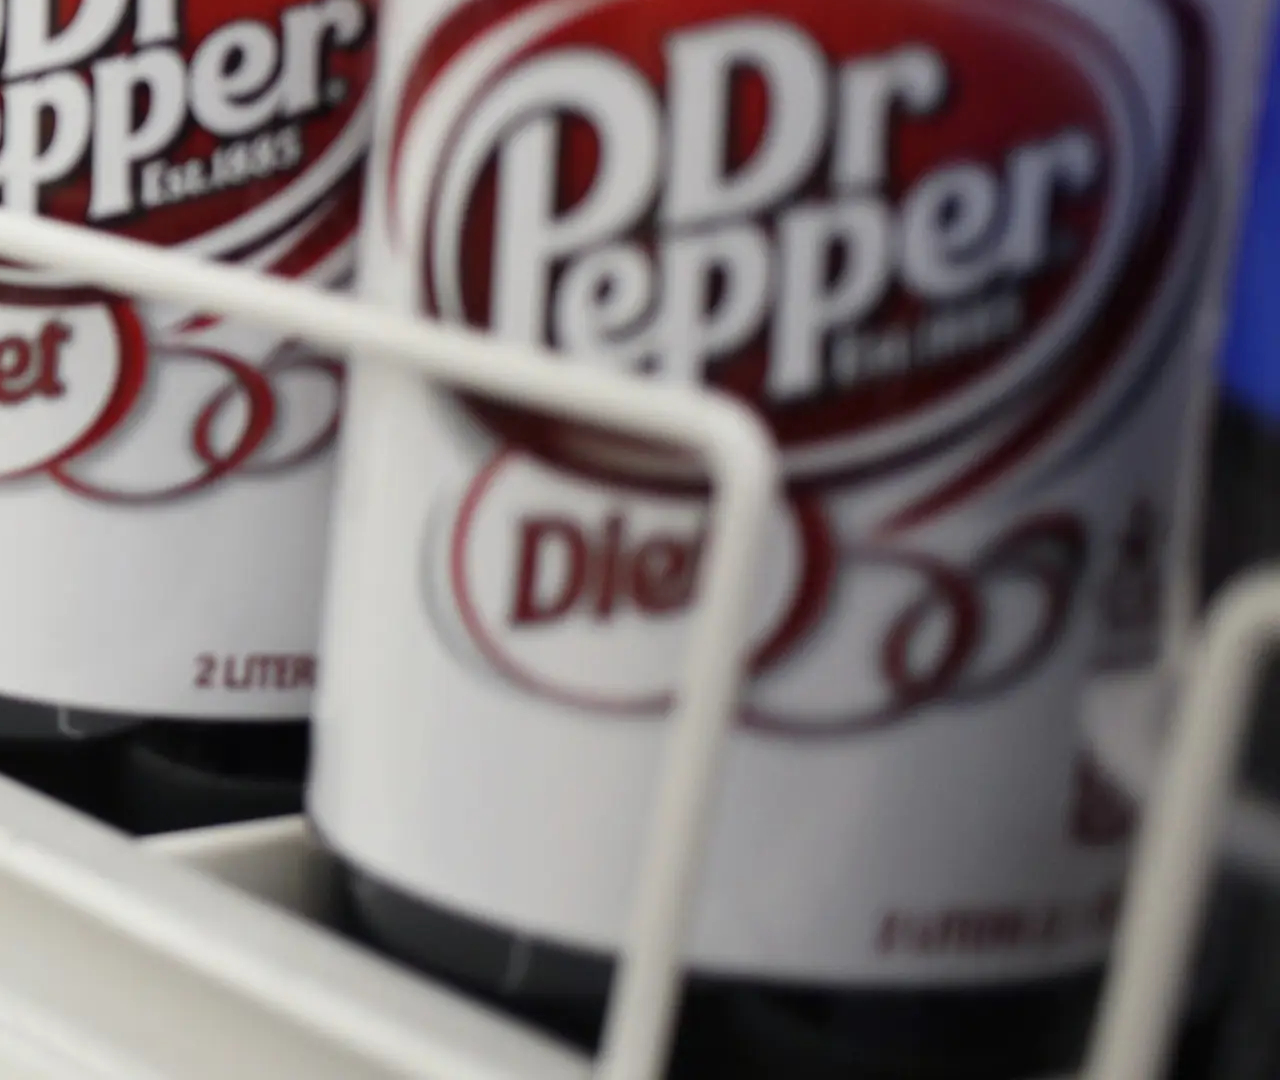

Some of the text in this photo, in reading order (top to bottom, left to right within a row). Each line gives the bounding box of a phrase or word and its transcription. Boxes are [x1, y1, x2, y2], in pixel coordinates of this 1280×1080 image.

[659, 16, 947, 224] Dr
[434, 49, 1096, 400] Pepper
[507, 514, 702, 626] Die
[193, 652, 318, 692] 2 LITER
